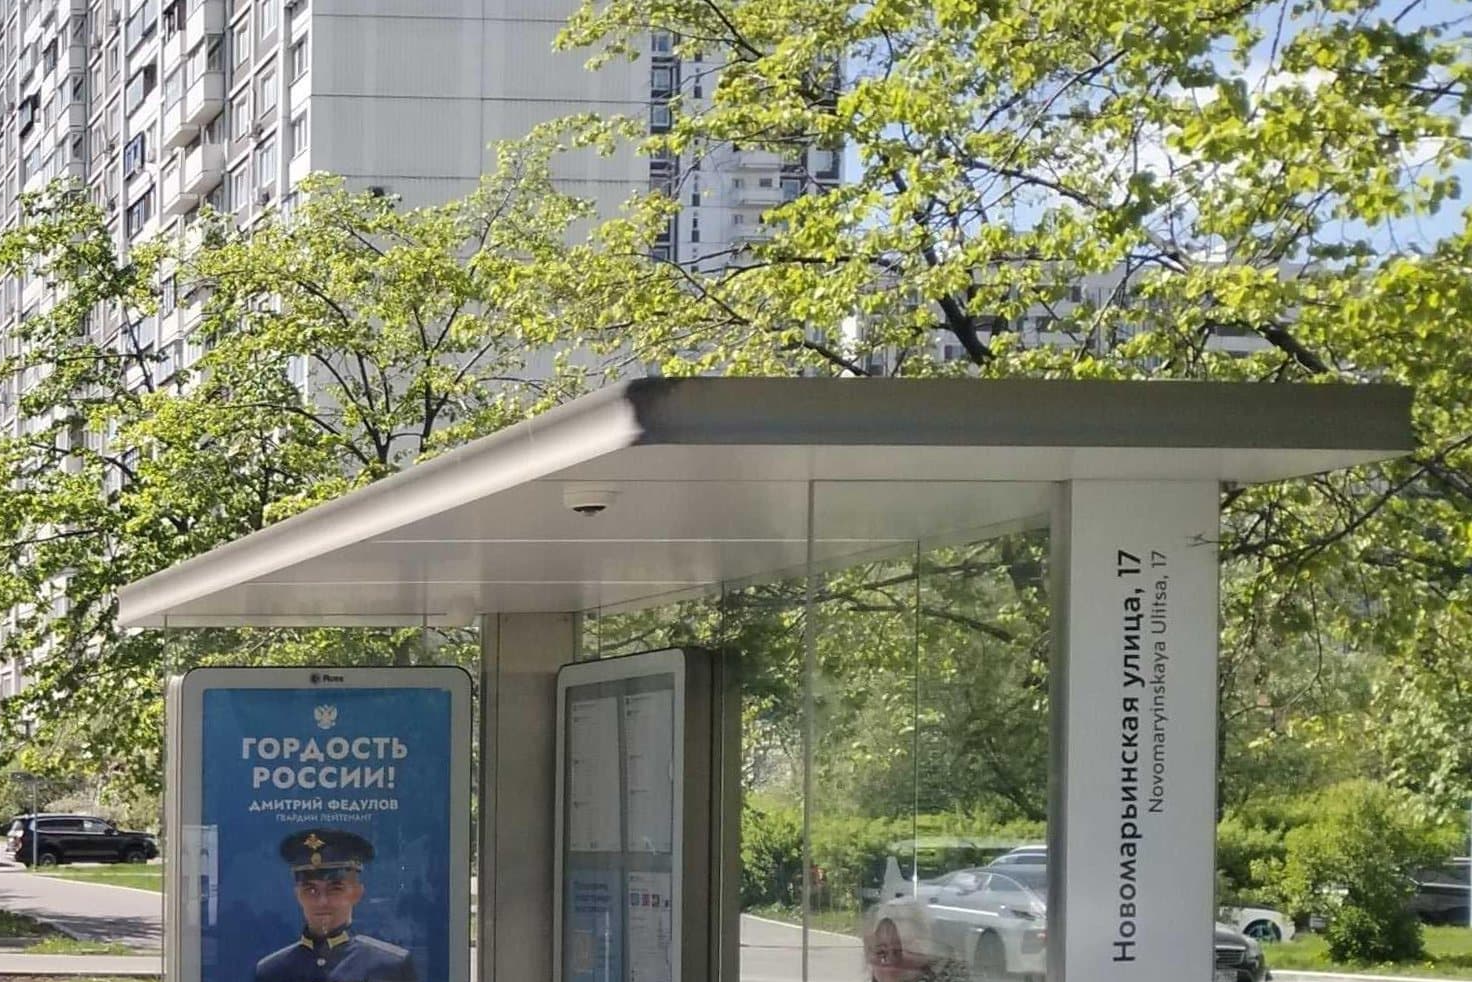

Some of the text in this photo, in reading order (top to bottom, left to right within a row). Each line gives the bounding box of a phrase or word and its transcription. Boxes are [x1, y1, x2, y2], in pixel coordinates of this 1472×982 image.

[1148, 551, 1170, 813] Novomaryinskaya Ulitsa, 17
[242, 737, 408, 762] ГОРДОСТЬ
[1112, 550, 1145, 962] Новомарьинская улица, 17
[253, 766, 396, 789] РОССИИ!
[249, 797, 398, 812] ДМИТРИЙ ФЕДУЛОВ
